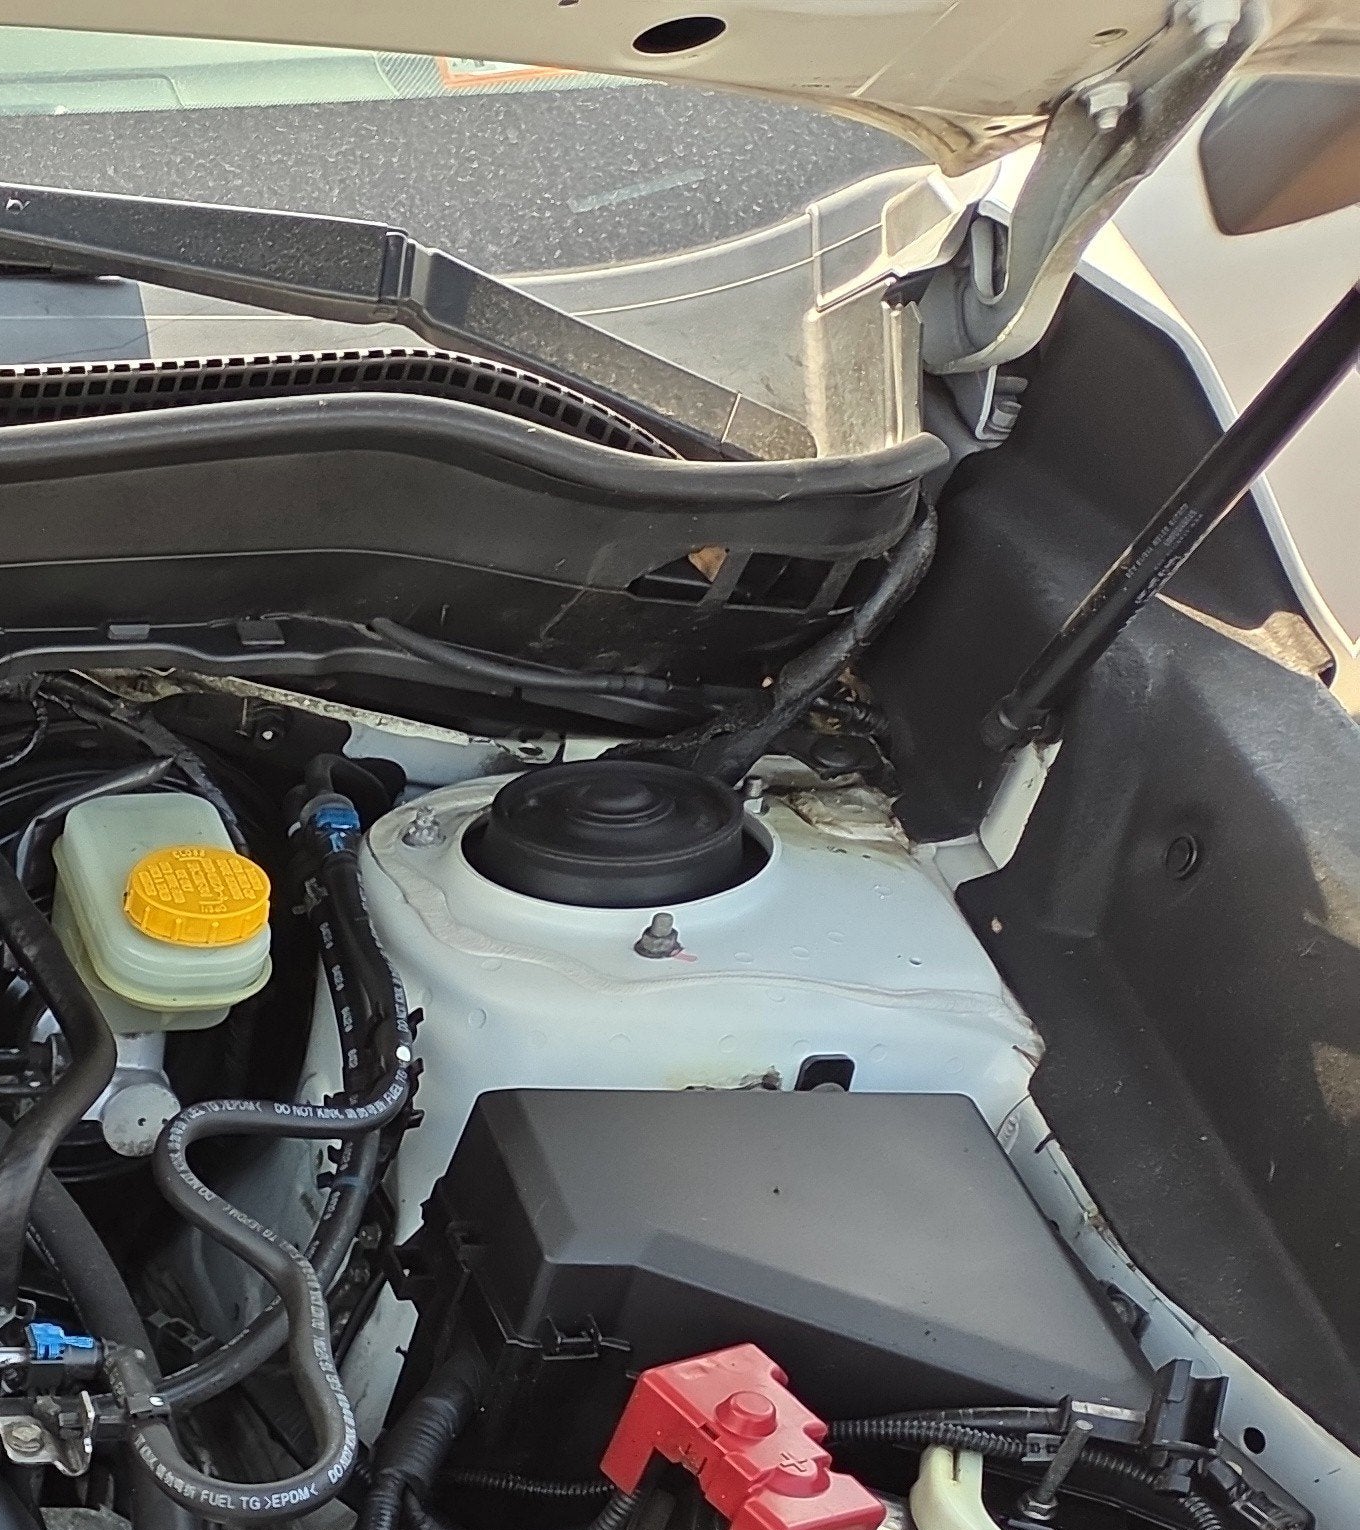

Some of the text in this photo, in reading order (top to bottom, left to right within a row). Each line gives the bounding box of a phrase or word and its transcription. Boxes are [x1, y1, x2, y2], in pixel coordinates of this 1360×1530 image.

[273, 1102, 290, 1115] DO
[200, 1489, 261, 1510] FUEL TG
